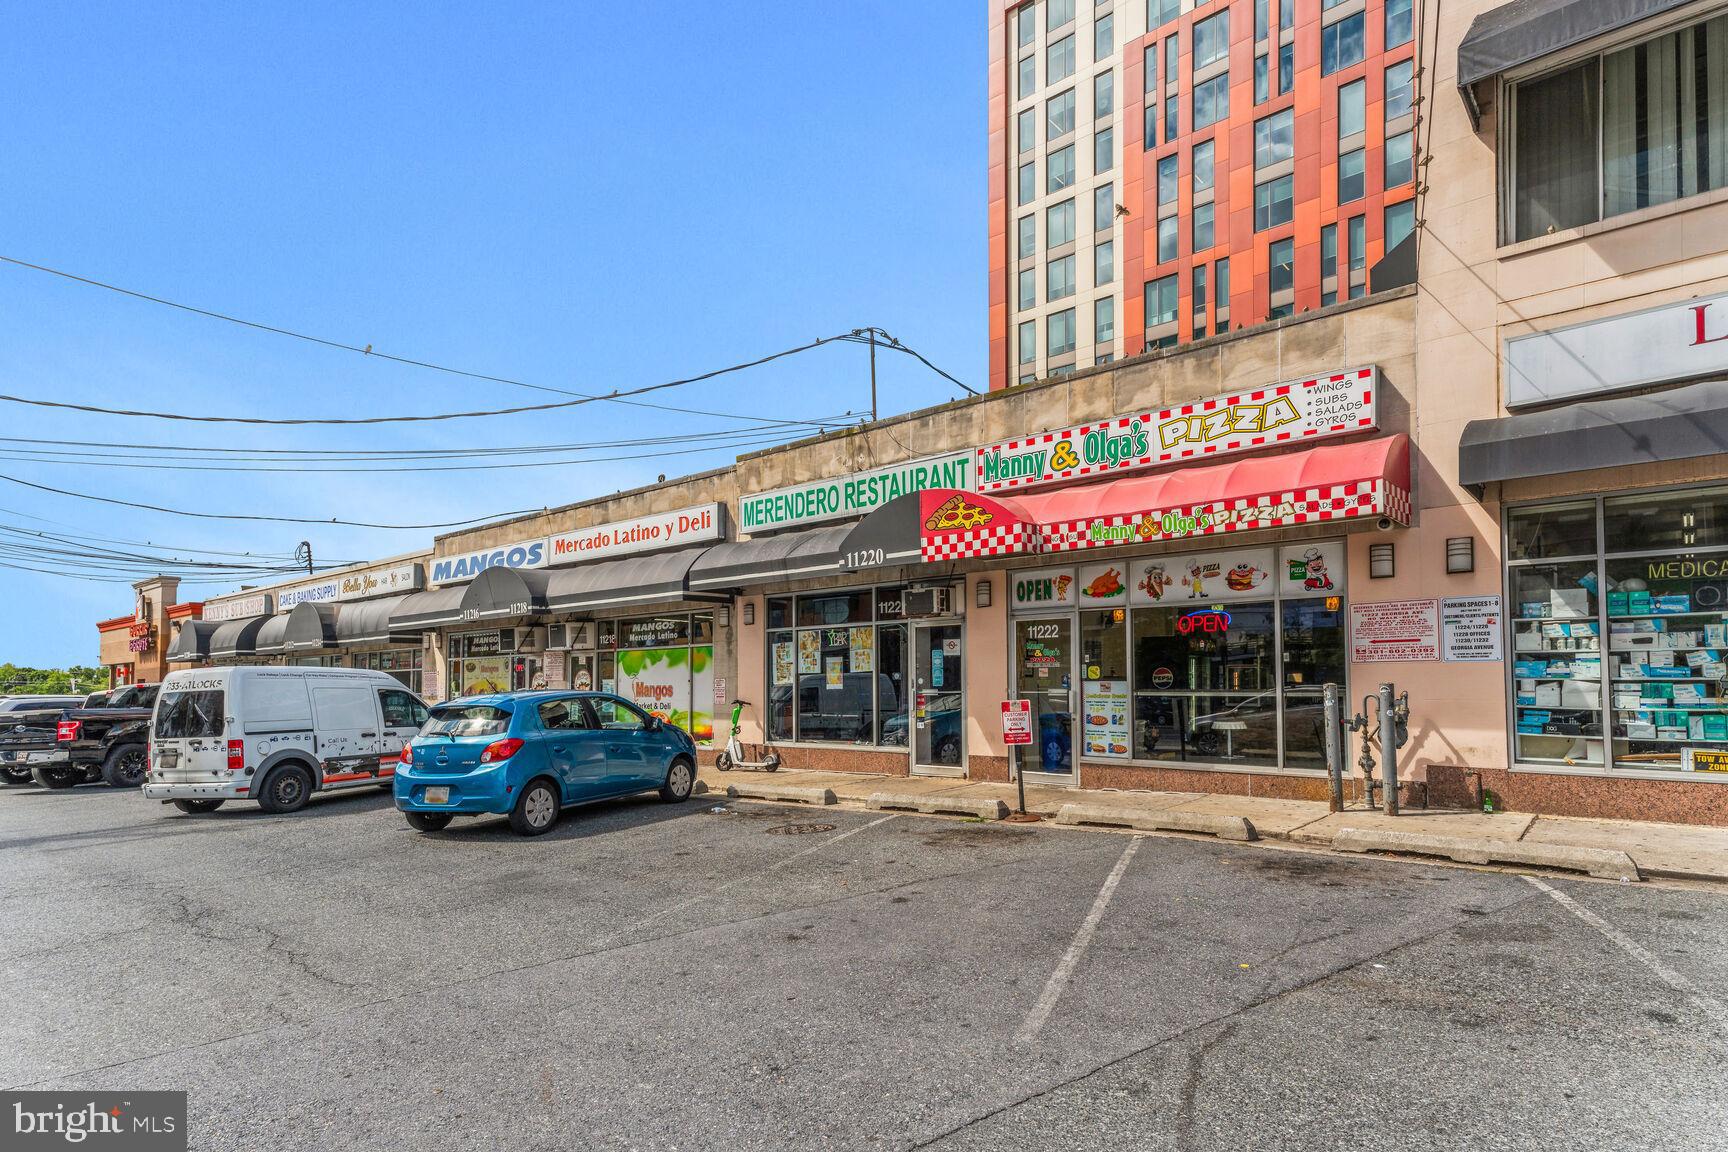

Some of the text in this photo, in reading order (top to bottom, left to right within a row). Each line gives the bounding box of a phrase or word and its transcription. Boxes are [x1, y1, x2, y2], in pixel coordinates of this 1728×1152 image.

[1313, 380, 1353, 395] WINGS
[1315, 393, 1348, 407] SUBS
[1315, 400, 1363, 417] SALADS
[1315, 412, 1357, 427] GYROS
[983, 395, 1302, 482] Manny & Olga's PIZZA
[743, 457, 970, 527] MERENDERO RESTAURANT
[1090, 522, 1137, 542] Manny
[1139, 516, 1160, 537] &
[1161, 507, 1210, 537] Olga's
[1213, 501, 1296, 526] PIZZA
[1299, 502, 1333, 512] SALADS
[1344, 495, 1376, 507] GYROS
[555, 510, 711, 555] Mercado Latino y Deli
[433, 543, 543, 581] MANGOS
[845, 548, 884, 568] 11220
[1202, 562, 1221, 573] PIZZA
[342, 577, 361, 595] Bella
[1016, 578, 1053, 603] OPEN
[279, 592, 292, 607] CAKE
[297, 588, 316, 604] BAKING
[316, 584, 337, 601] SUPPLY
[463, 609, 481, 620] 11216
[510, 602, 528, 615] 11218
[878, 600, 902, 614] 1122
[632, 621, 675, 632] MANGOS
[1177, 614, 1229, 633] OPEN
[629, 631, 678, 642] Mercado Latino
[1027, 624, 1059, 639] 11222
[473, 635, 500, 644] MANGO
[1153, 674, 1173, 682] PEPSI
[635, 682, 673, 701] Mangos
[659, 702, 672, 710] Deli
[1696, 755, 1715, 763] TOW
